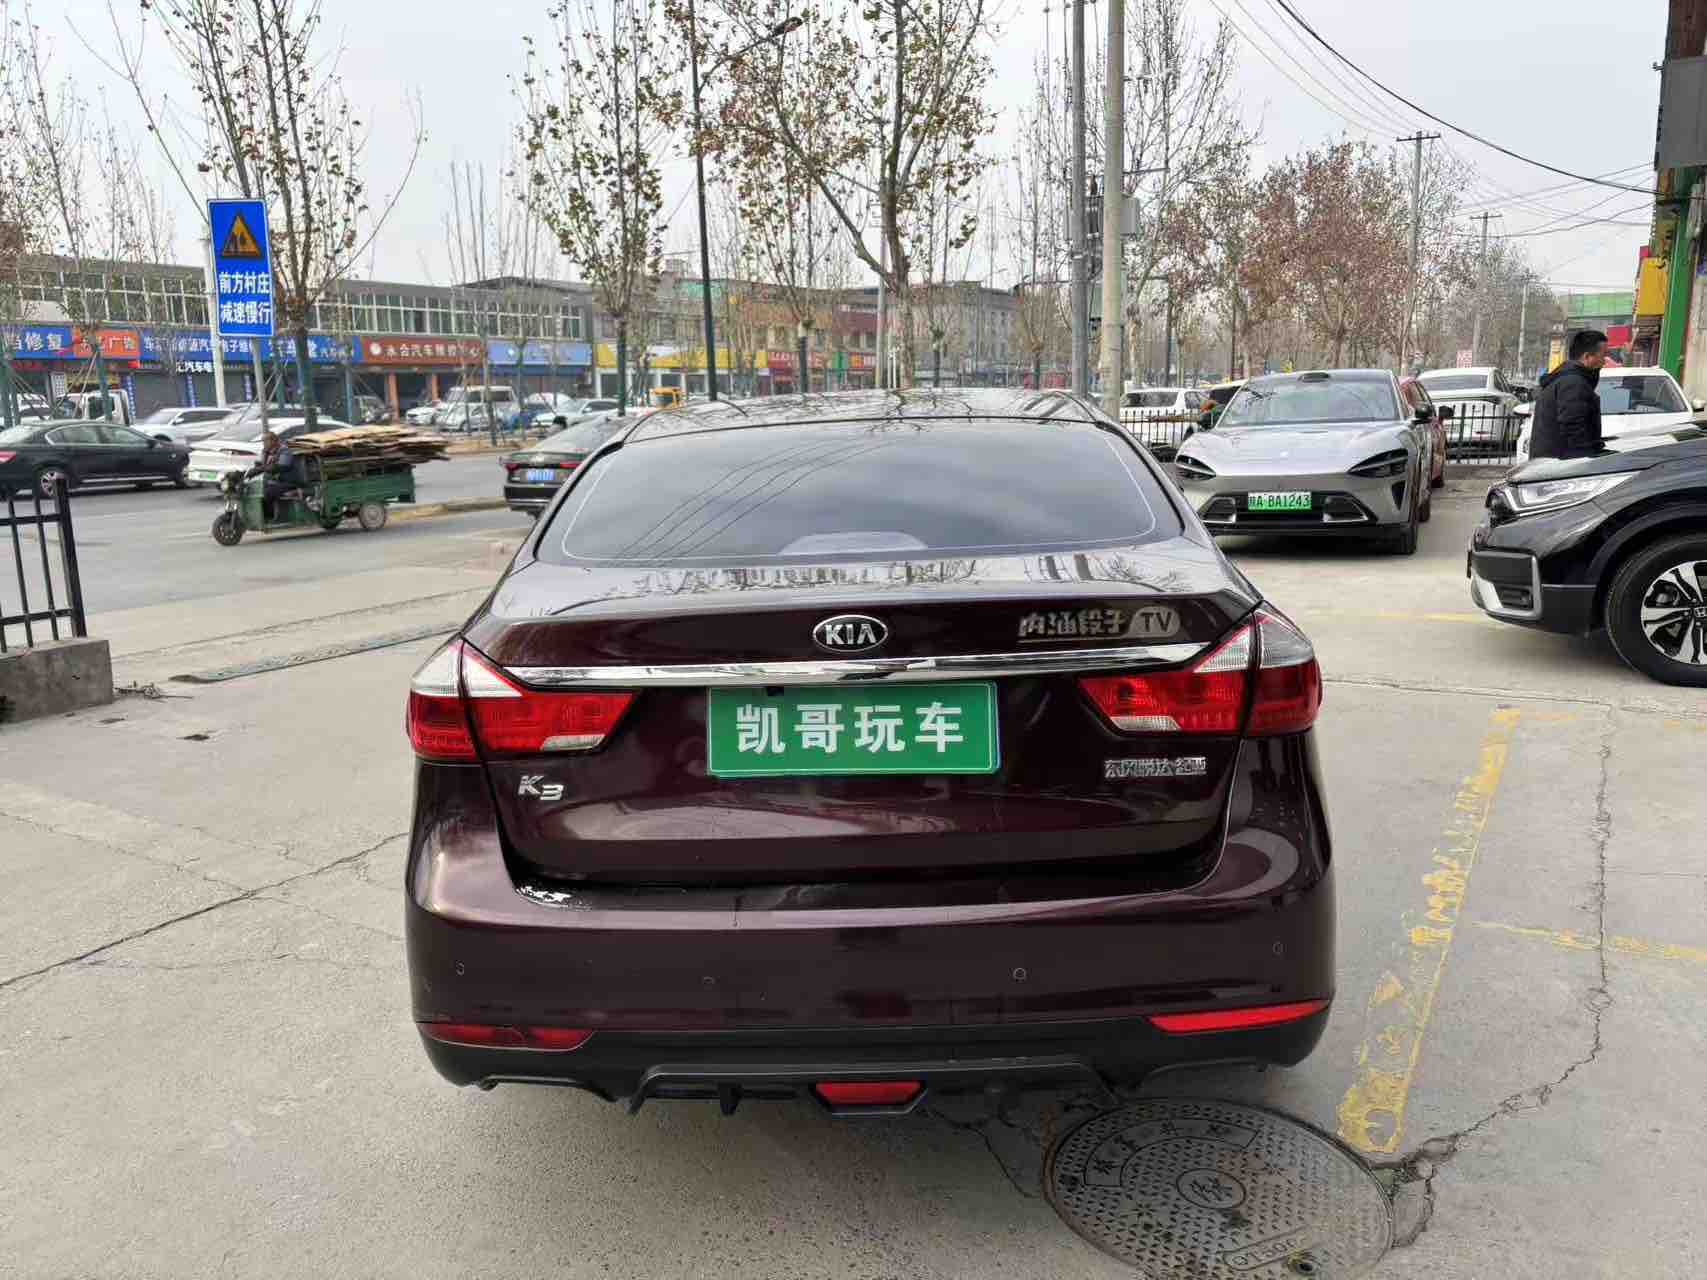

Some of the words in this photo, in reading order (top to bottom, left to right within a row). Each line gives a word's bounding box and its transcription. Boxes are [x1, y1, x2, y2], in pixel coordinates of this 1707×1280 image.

[219, 271, 270, 295] 前方村庄
[219, 301, 271, 325] 减速慢行
[825, 622, 877, 645] KIA
[1018, 608, 1127, 637] 内涵段子
[1140, 611, 1172, 633] TV
[736, 701, 965, 754] 凯哥玩车
[517, 774, 565, 801] K3
